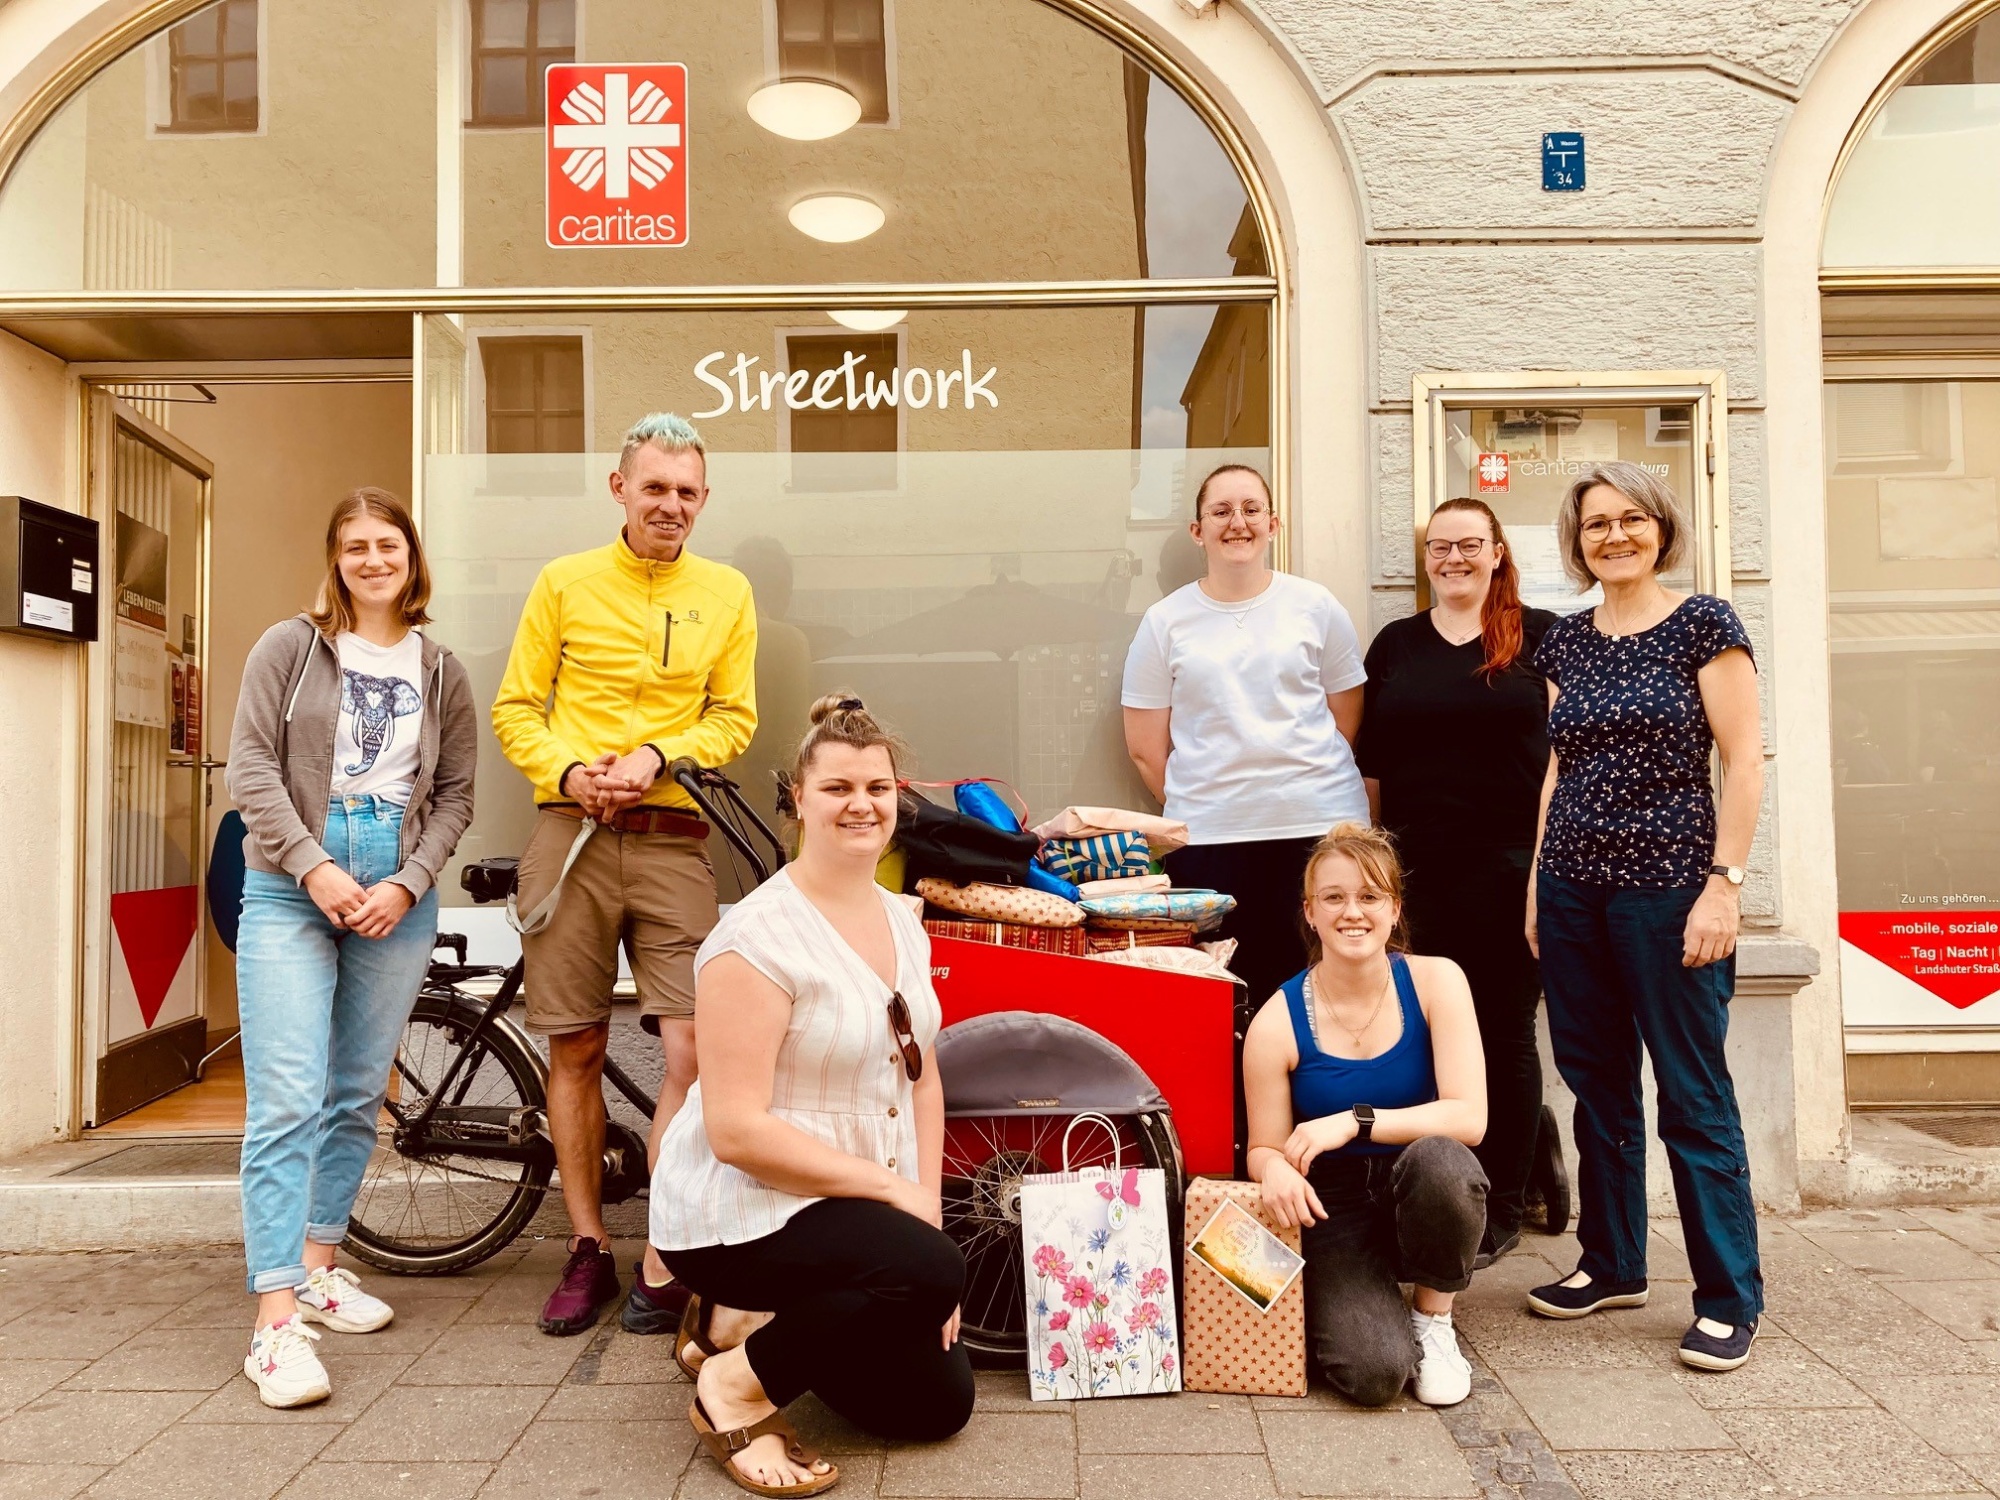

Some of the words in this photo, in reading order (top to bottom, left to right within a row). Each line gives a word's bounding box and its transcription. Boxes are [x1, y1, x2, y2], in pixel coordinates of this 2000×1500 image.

[1557, 173, 1573, 184] 34
[558, 206, 676, 242] caritas
[691, 348, 999, 419] Streetwork
[1481, 483, 1508, 492] caritas
[124, 589, 143, 608] LEBEN
[1901, 894, 1915, 903] Zu
[1919, 895, 1938, 903] uns
[1942, 894, 1986, 905] gehören
[1948, 922, 1998, 933] soziale
[1946, 946, 1988, 958] Nacht
[1915, 964, 1971, 974] Landshuter
